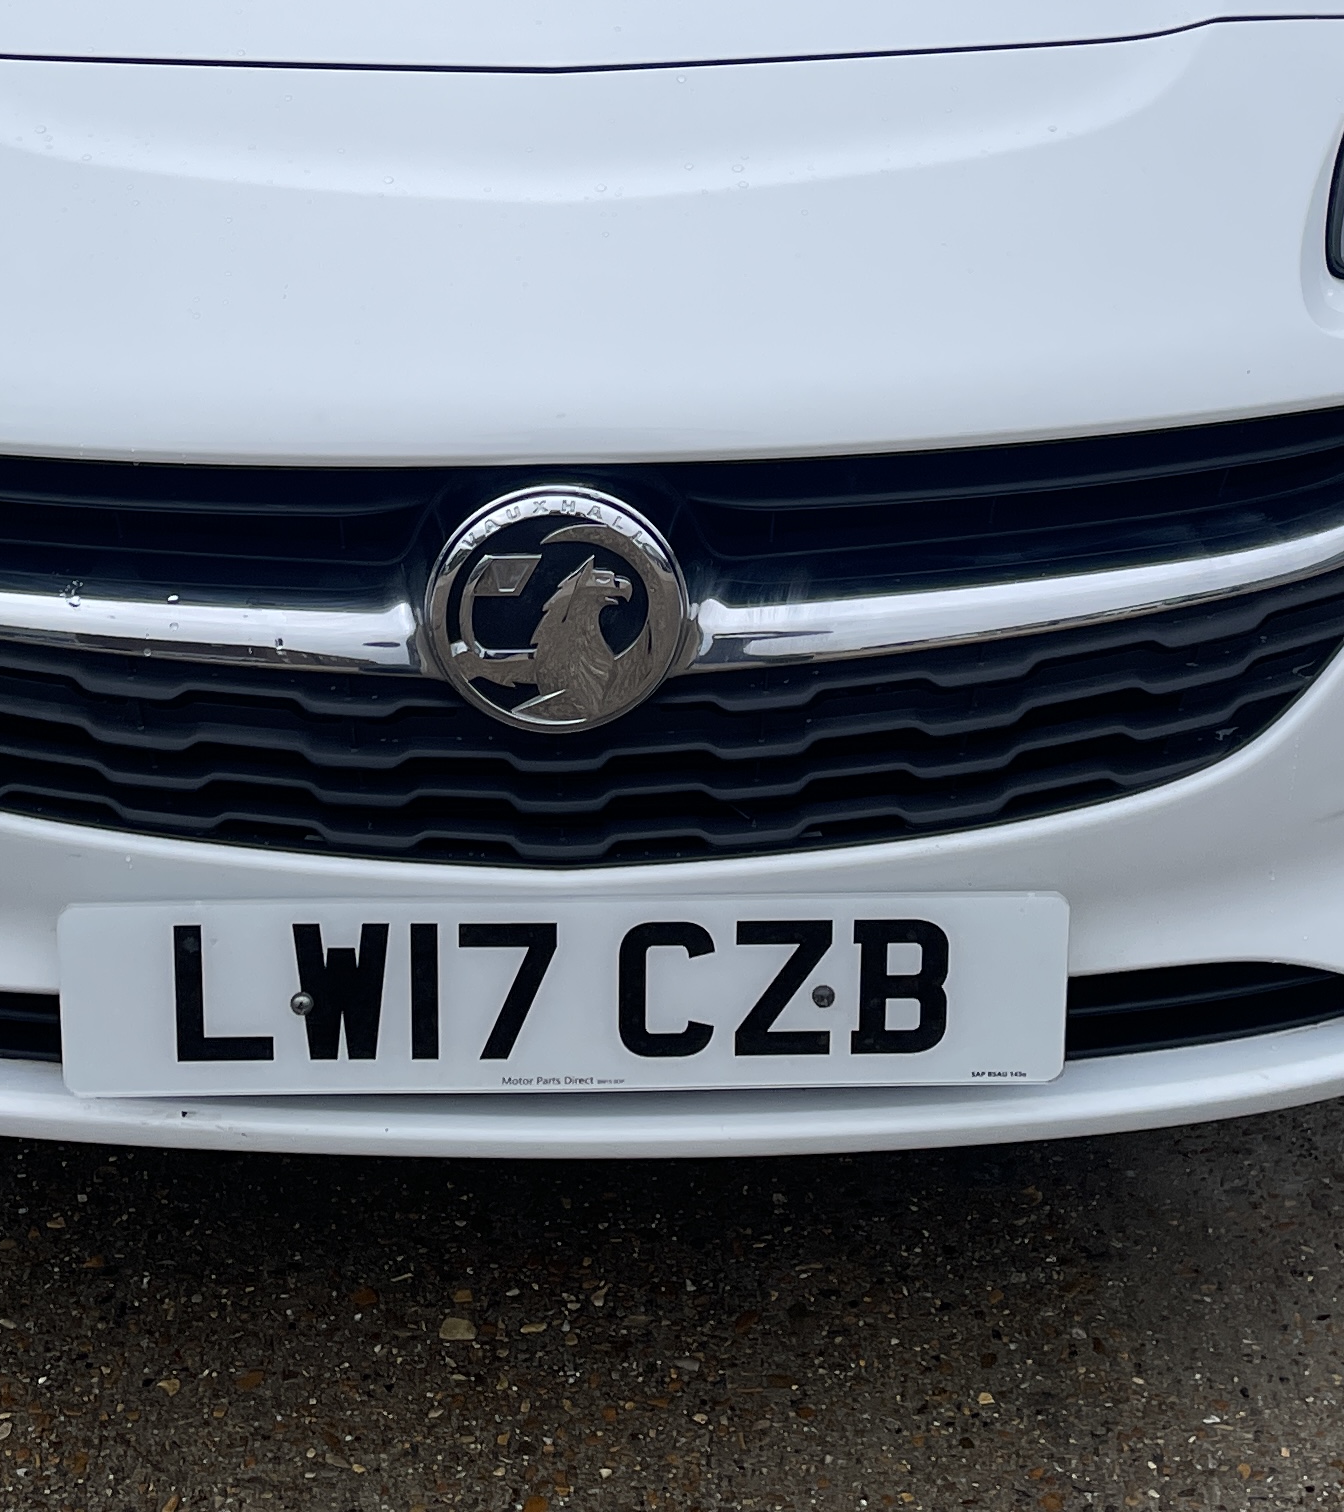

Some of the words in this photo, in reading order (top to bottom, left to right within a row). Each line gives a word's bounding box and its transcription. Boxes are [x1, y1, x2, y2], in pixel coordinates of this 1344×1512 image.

[460, 499, 645, 548] VAUXHALL
[172, 921, 559, 1063] LW17
[617, 918, 950, 1060] CZB
[501, 1076, 533, 1086] Motor
[536, 1076, 561, 1086] Parts
[564, 1076, 594, 1085] Direct
